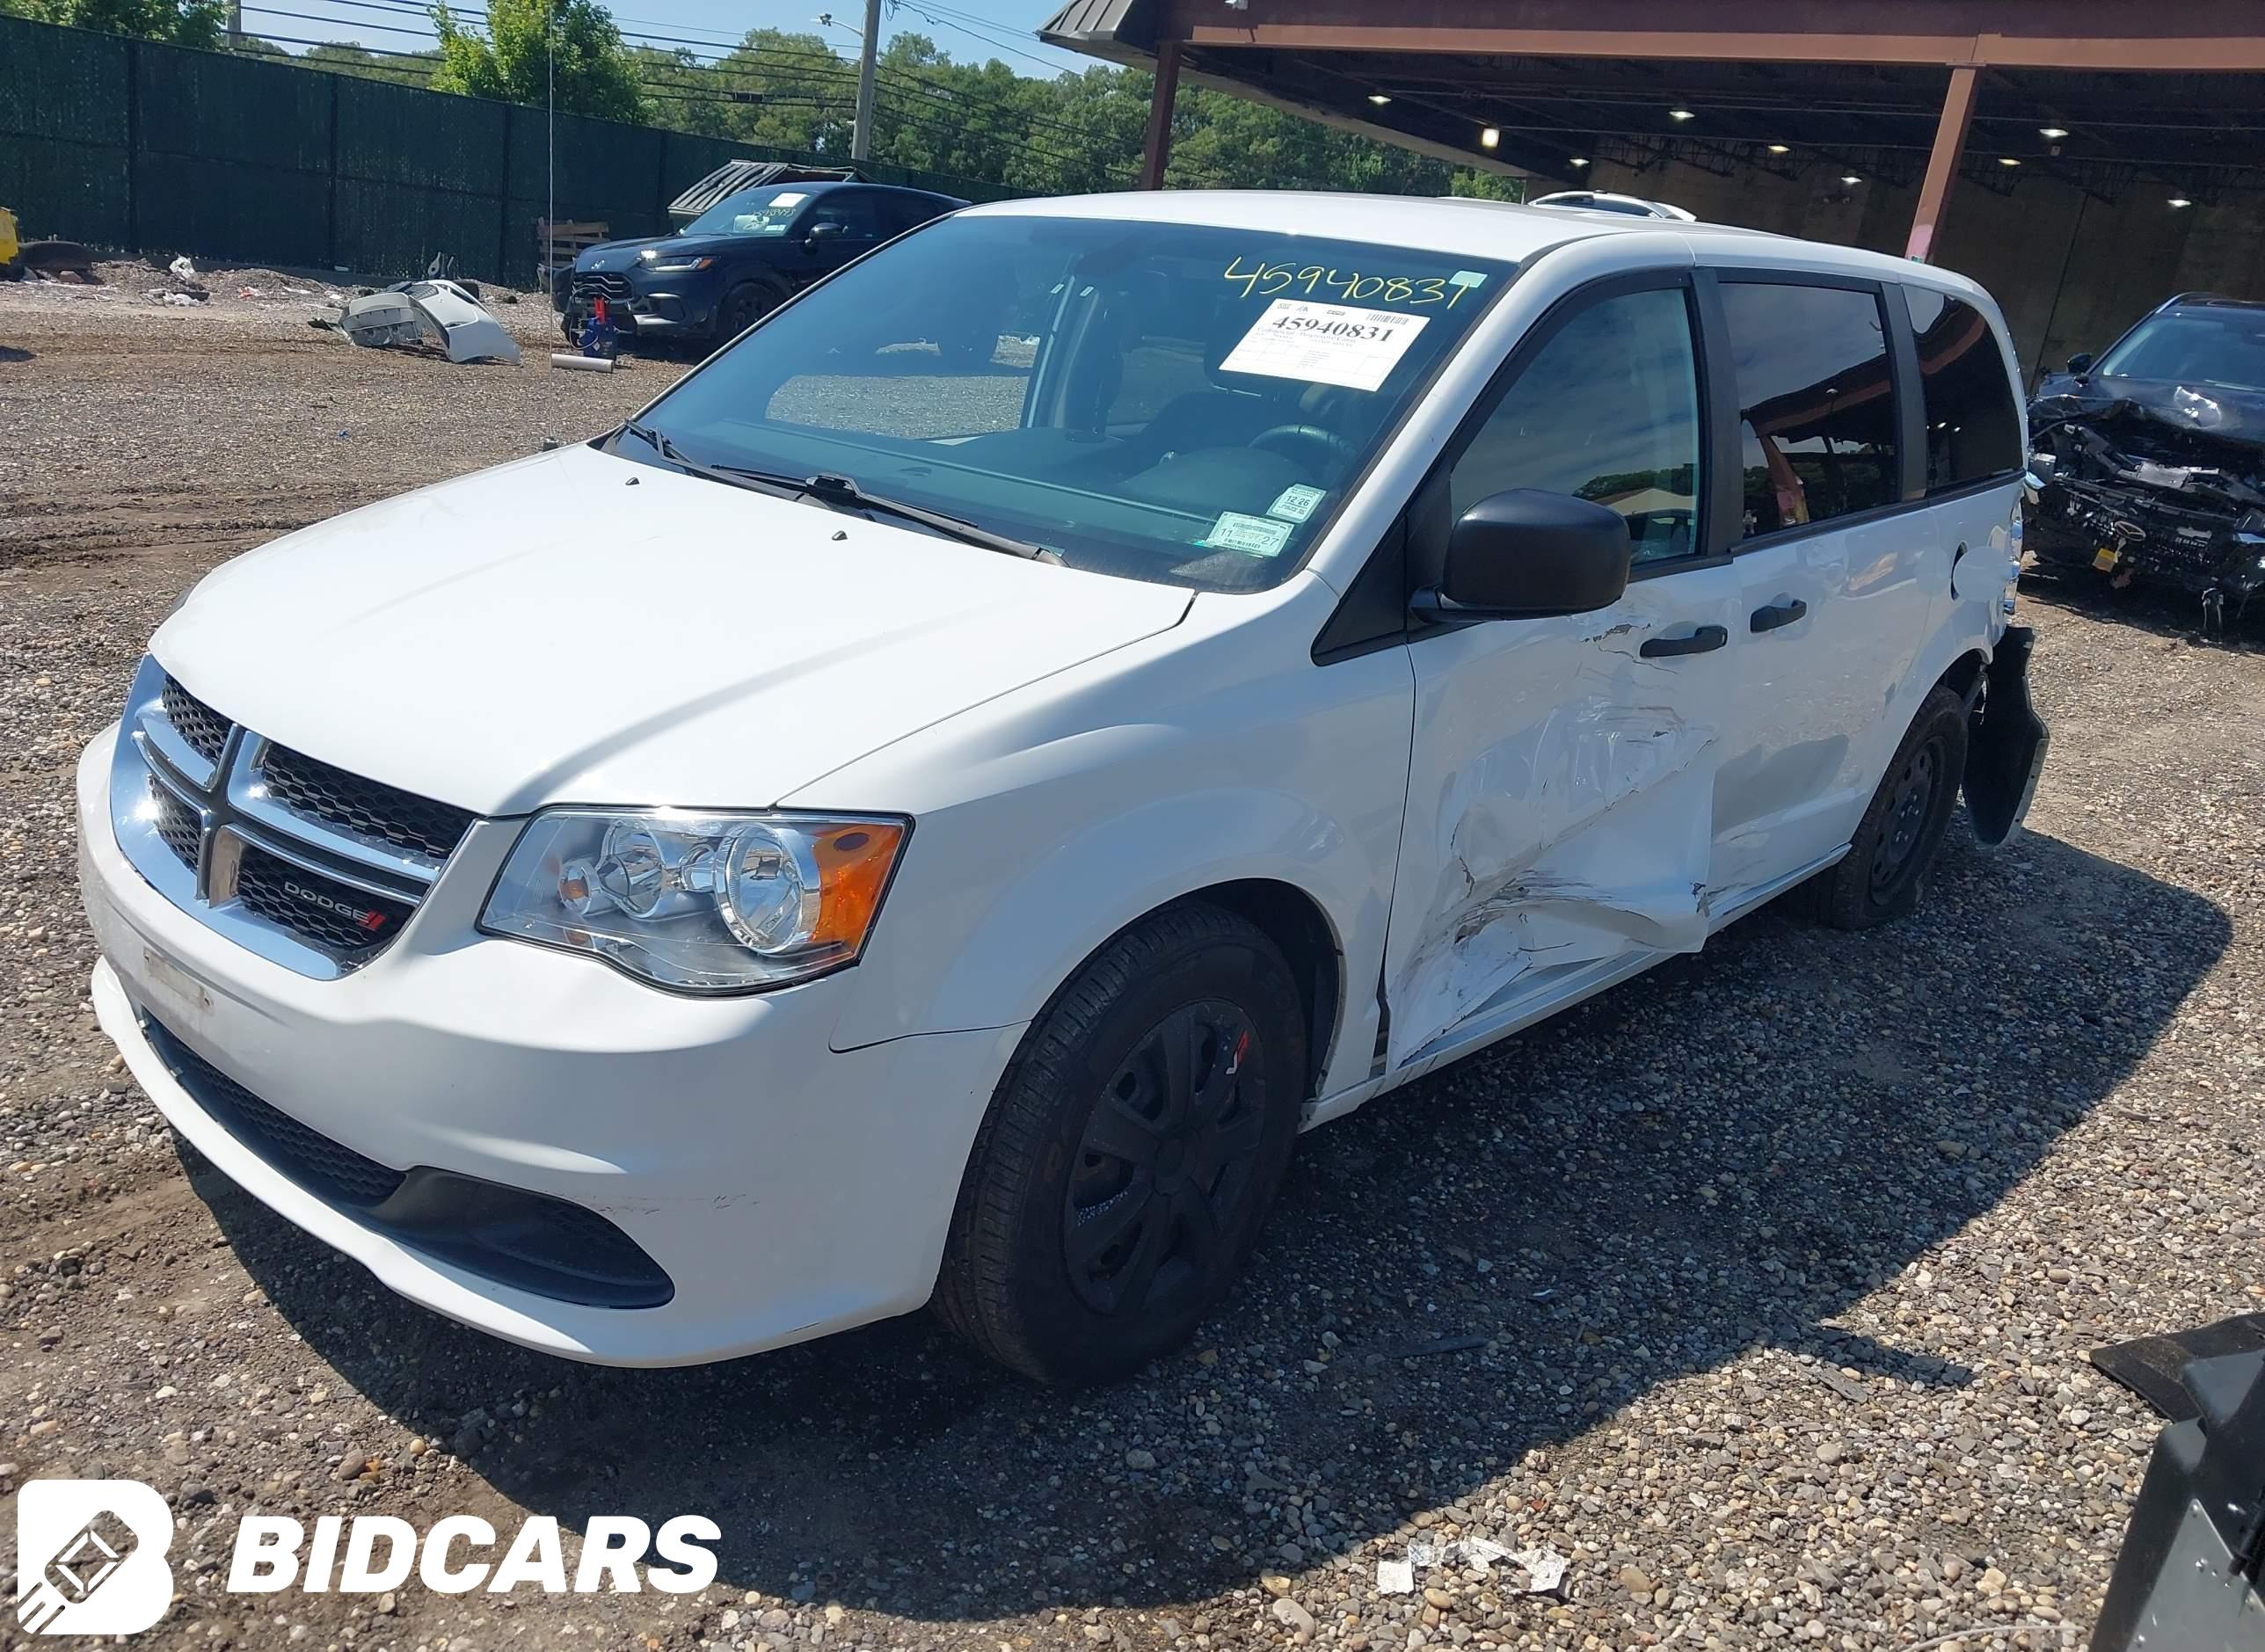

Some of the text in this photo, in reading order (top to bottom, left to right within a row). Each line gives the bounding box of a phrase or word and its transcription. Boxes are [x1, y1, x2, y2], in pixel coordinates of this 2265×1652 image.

[1224, 256, 1471, 309] 45940831
[1272, 316, 1394, 342] 45940831
[1298, 498, 1310, 506] 26
[1261, 535, 1279, 547] 27
[284, 881, 370, 924] DODGE
